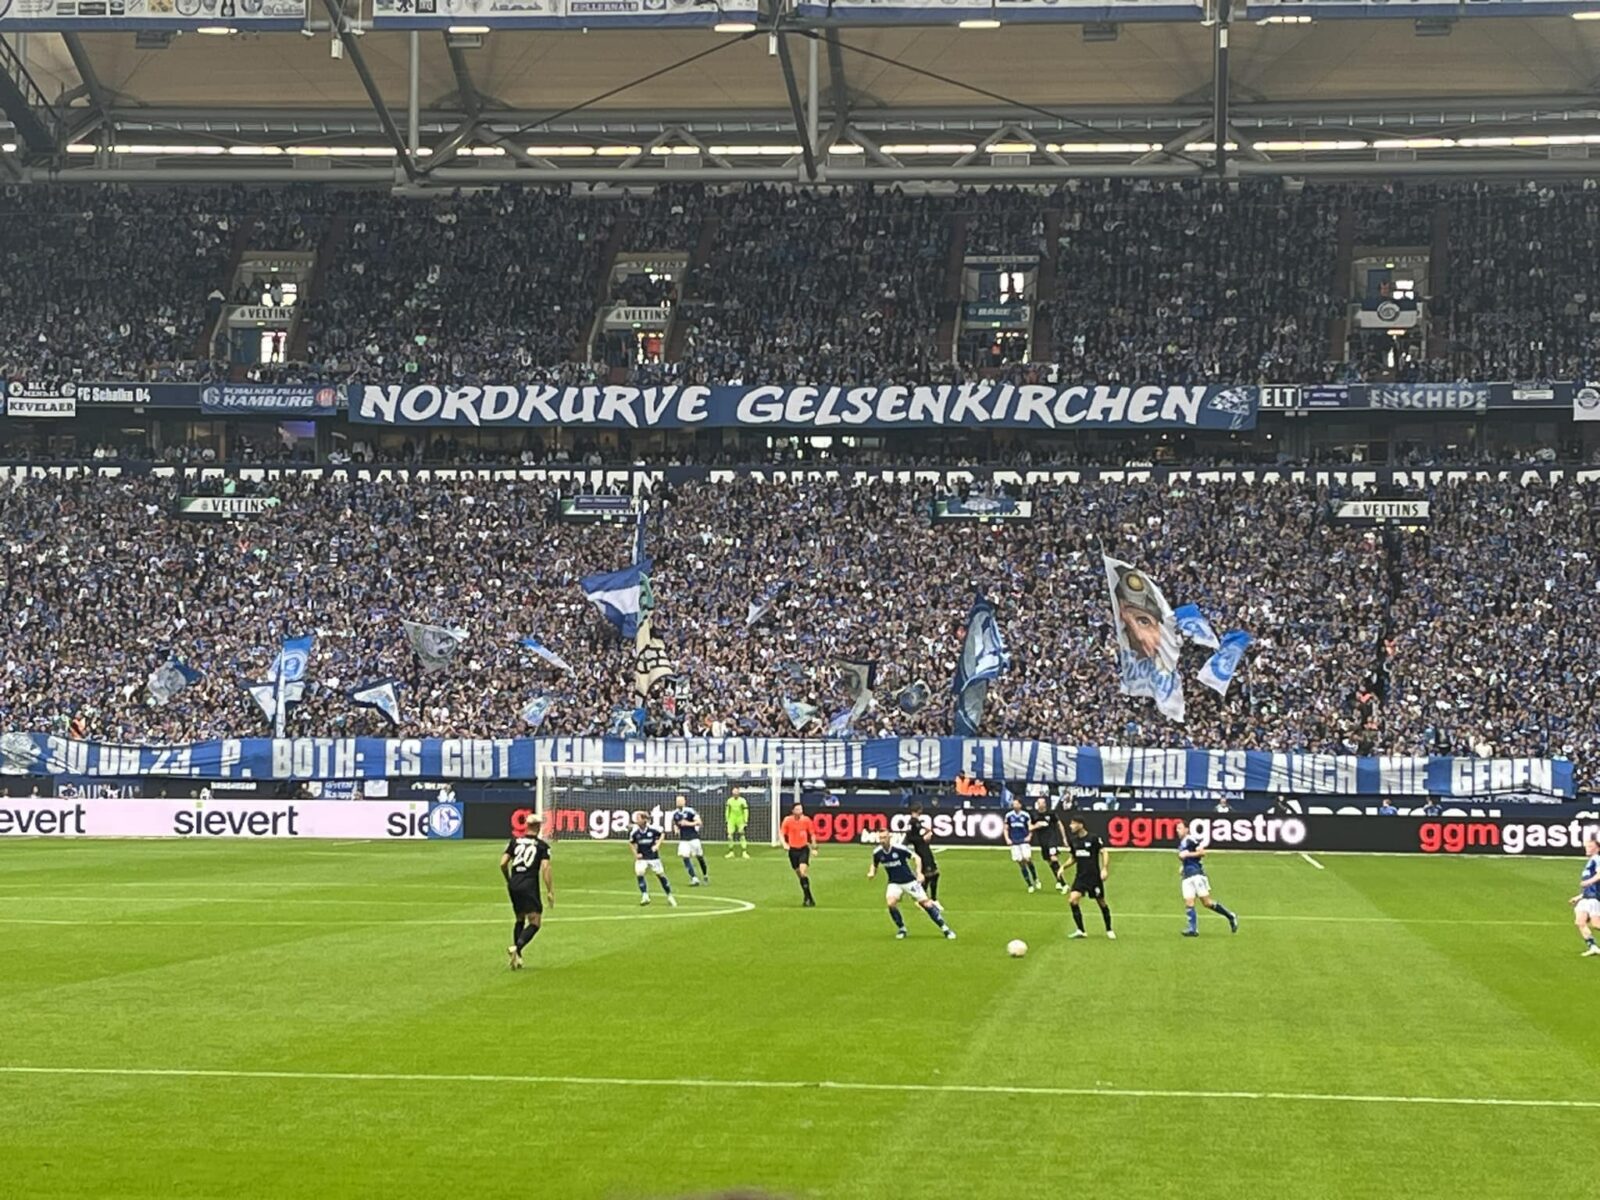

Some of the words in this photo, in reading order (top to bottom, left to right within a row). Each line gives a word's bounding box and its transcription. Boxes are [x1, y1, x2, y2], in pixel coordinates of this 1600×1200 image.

[249, 308, 294, 318] VELTINS
[624, 309, 668, 319] VELTINS
[223, 395, 314, 407] HAMBURG
[360, 384, 711, 428] NORDKURVE
[737, 385, 1207, 428] GELSENKIRCHEN
[1370, 389, 1487, 408] ENSCHEDE
[211, 499, 265, 511] VELTINS
[1363, 504, 1419, 515] VELTINS
[386, 739, 421, 776] ES
[441, 738, 514, 778] GIBT
[535, 737, 603, 777] KEIN
[898, 738, 941, 779] SO
[1101, 746, 1187, 786] WIRD
[1207, 750, 1247, 790] ES
[1267, 752, 1357, 794] AUCH
[1379, 754, 1429, 794] NIE
[174, 802, 299, 836] sievert
[1420, 822, 1499, 851] ggm
[513, 843, 537, 868] 20
